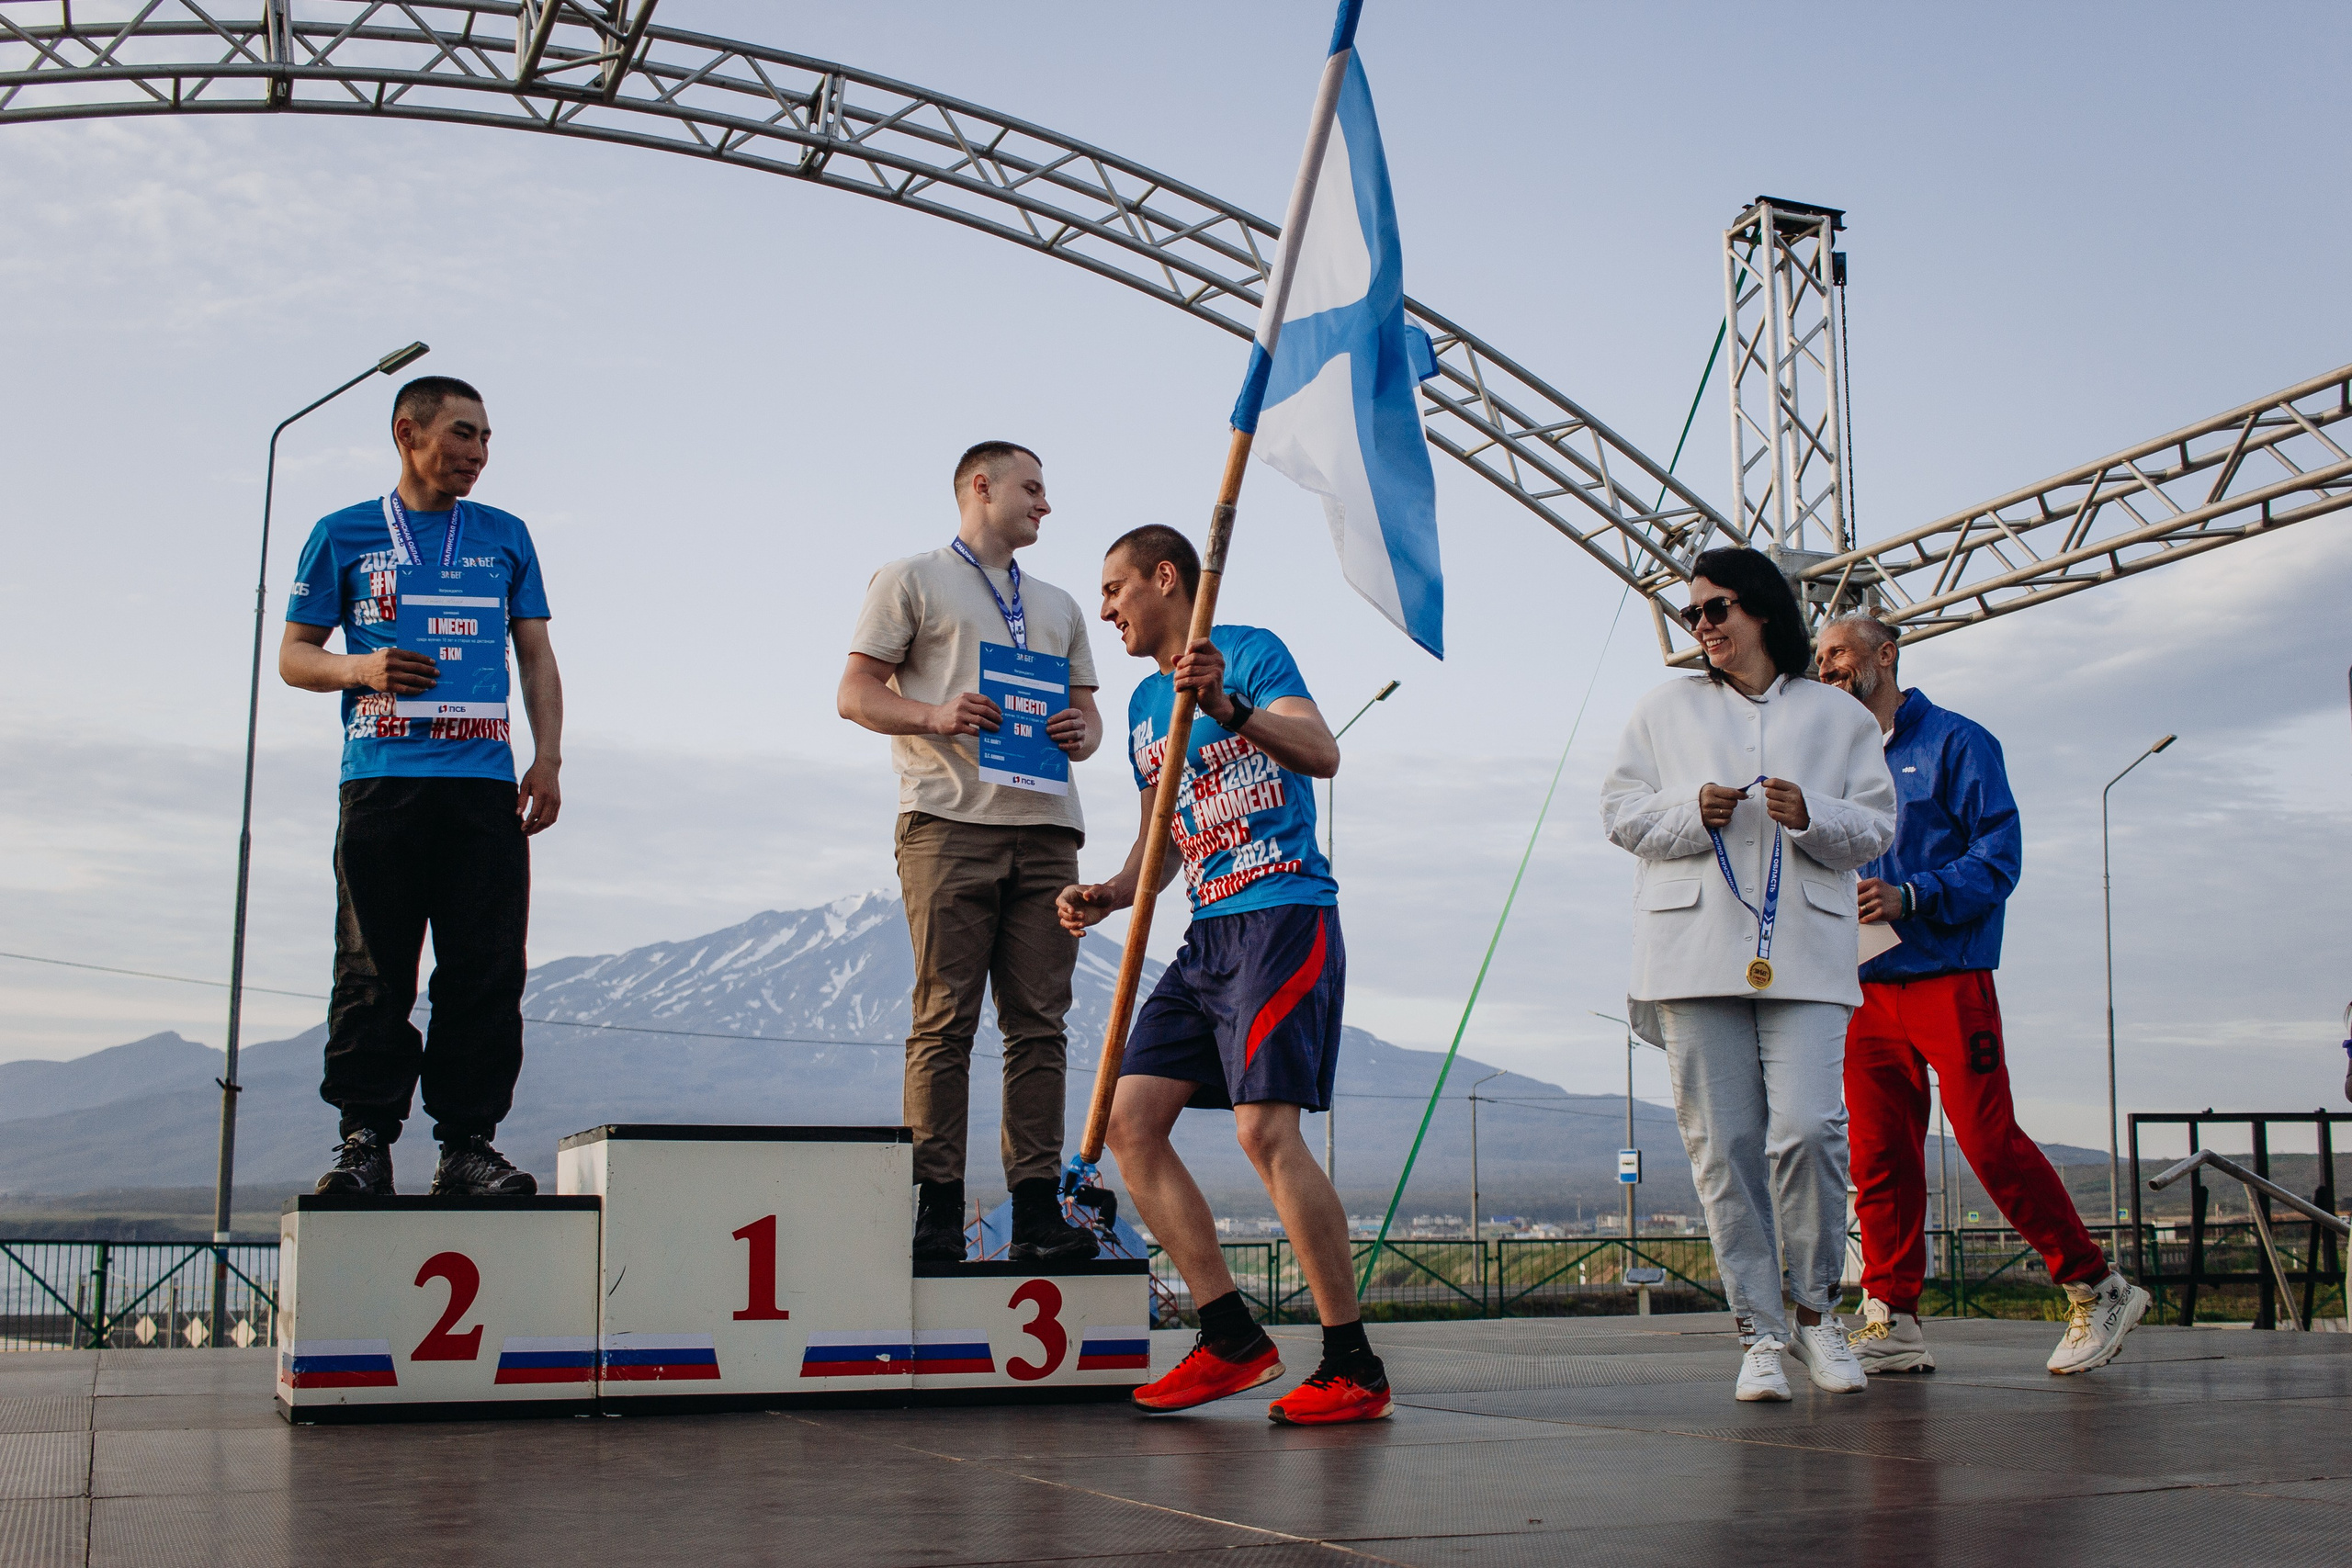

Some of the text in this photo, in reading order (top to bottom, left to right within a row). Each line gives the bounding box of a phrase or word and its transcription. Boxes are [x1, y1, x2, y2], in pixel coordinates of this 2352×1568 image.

[438, 617, 479, 636] МЕСТО
[439, 647, 447, 660] 5
[1015, 695, 1047, 716] МЕСТО
[1013, 722, 1020, 736] 5
[1021, 778, 1035, 786] ПСБ
[1191, 779, 1285, 830] #МОМЕНТ
[1230, 837, 1283, 873] 2024
[1770, 853, 1780, 893] ОБЛАСТЬ
[1969, 1030, 2000, 1074] 8
[732, 1214, 790, 1320] 1
[412, 1252, 483, 1361] 2
[1007, 1280, 1066, 1380] 3
